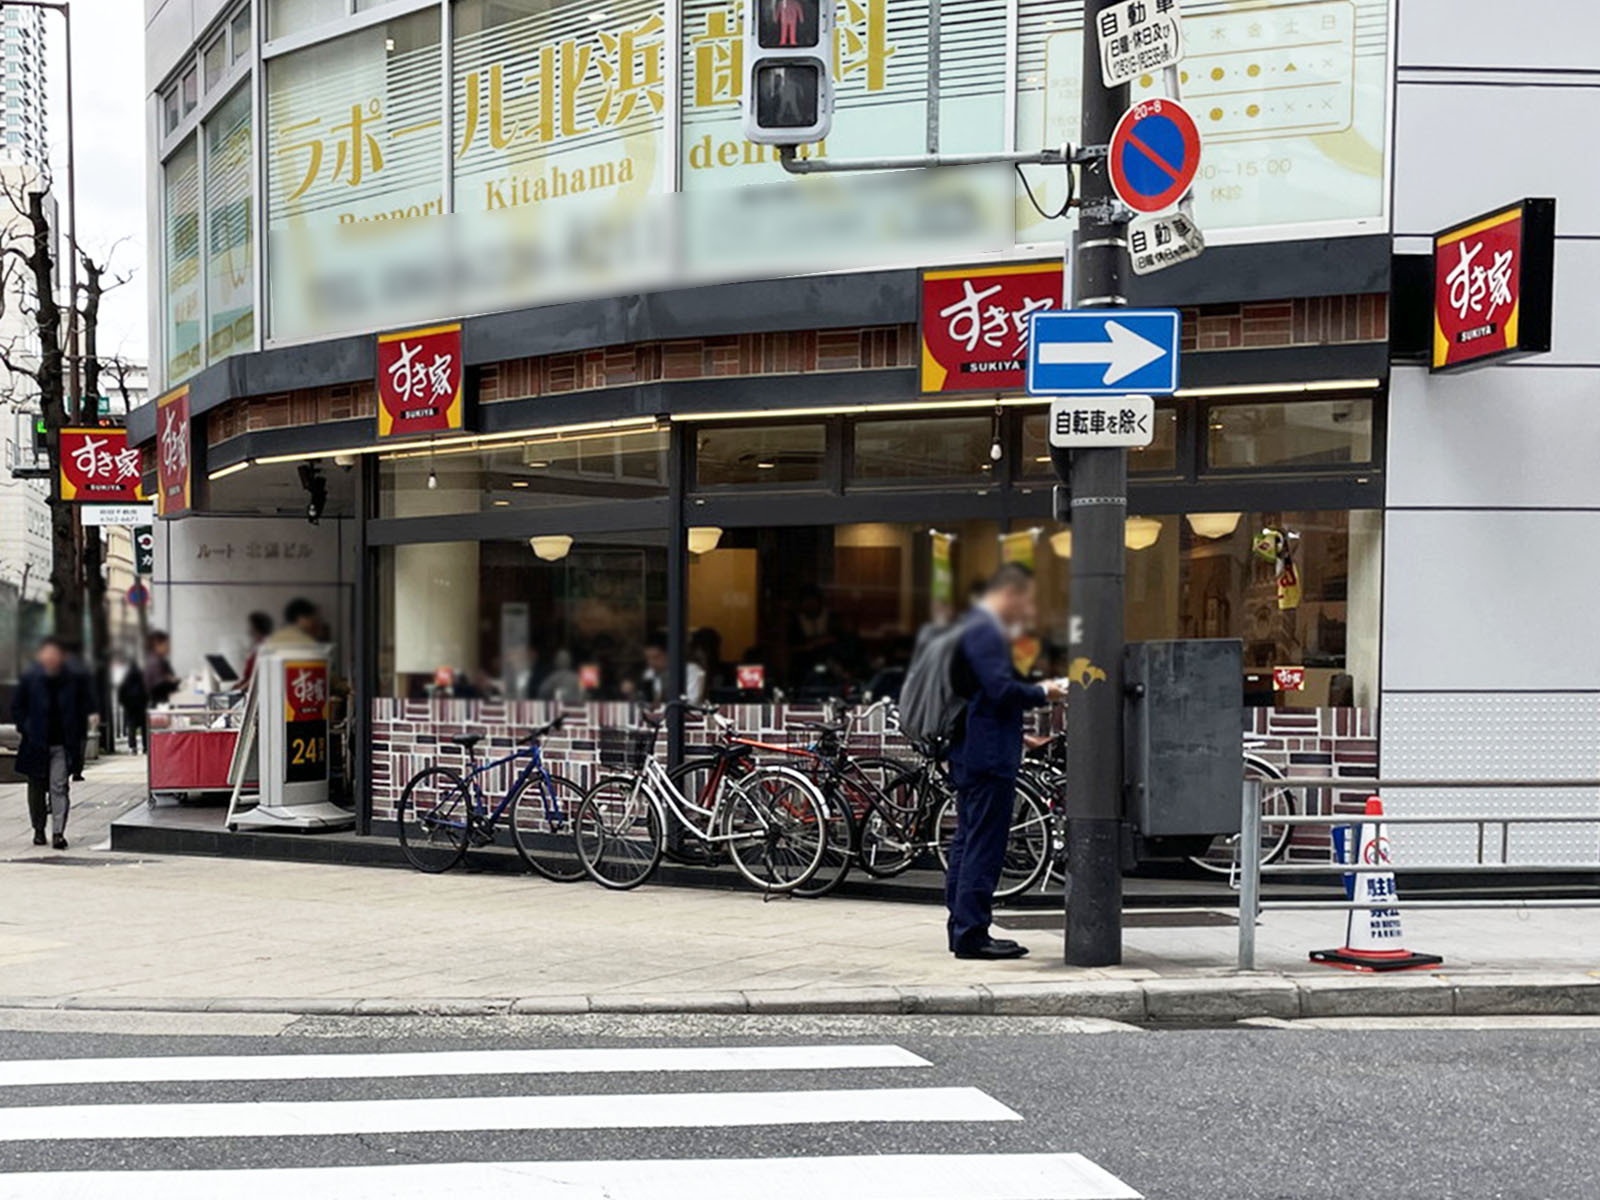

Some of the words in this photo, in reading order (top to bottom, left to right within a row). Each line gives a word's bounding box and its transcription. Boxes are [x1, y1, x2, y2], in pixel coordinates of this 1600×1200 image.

[1134, 100, 1162, 121] 20-8
[485, 157, 635, 212] Kitahama
[1131, 219, 1191, 253] 自動車
[1446, 241, 1513, 321] すき家
[1461, 325, 1492, 342] SUKIYA
[388, 341, 452, 405] すき家
[969, 361, 1021, 372] SUKIYA
[1056, 409, 1148, 435] 自転車を除く
[71, 435, 140, 484] すき家
[292, 738, 316, 764] 24
